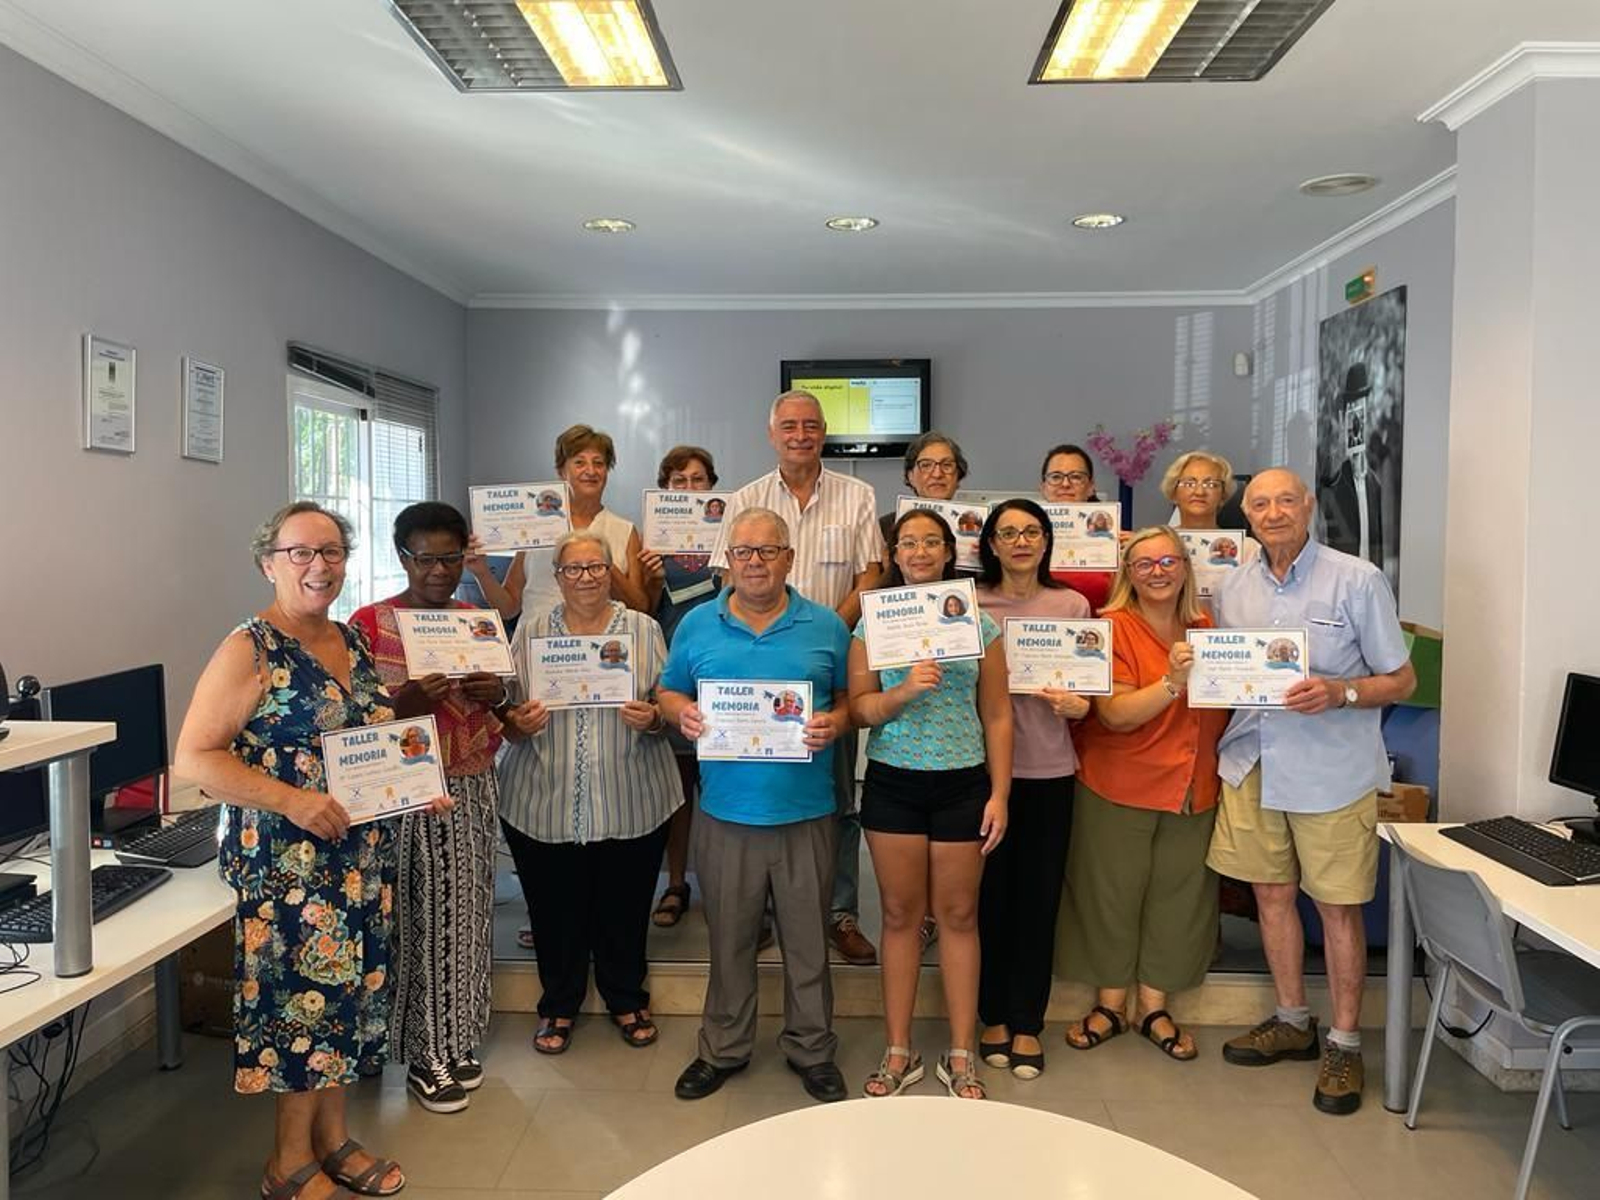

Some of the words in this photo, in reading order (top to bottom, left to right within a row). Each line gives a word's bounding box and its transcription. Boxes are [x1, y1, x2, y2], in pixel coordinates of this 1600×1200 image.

[487, 489, 519, 499] TALLER
[659, 494, 689, 502] TALLER
[483, 502, 525, 513] MEMORIA
[654, 507, 693, 515] MEMORIA
[880, 591, 917, 604] TALLER
[413, 613, 449, 622] TALLER
[876, 606, 925, 620] MEMORIA
[412, 626, 458, 634] MEMORIA
[1022, 624, 1057, 633] TALLER
[547, 639, 581, 649] TALLER
[1017, 638, 1062, 647] MEMORIA
[1206, 635, 1246, 644] TALLER
[541, 653, 587, 663] MEMORIA
[1201, 649, 1251, 660] MEMORIA
[717, 686, 754, 696] TALLER
[711, 702, 760, 712] MEMORIA
[341, 732, 379, 747] TALLER
[339, 748, 387, 766] MEMORIA
